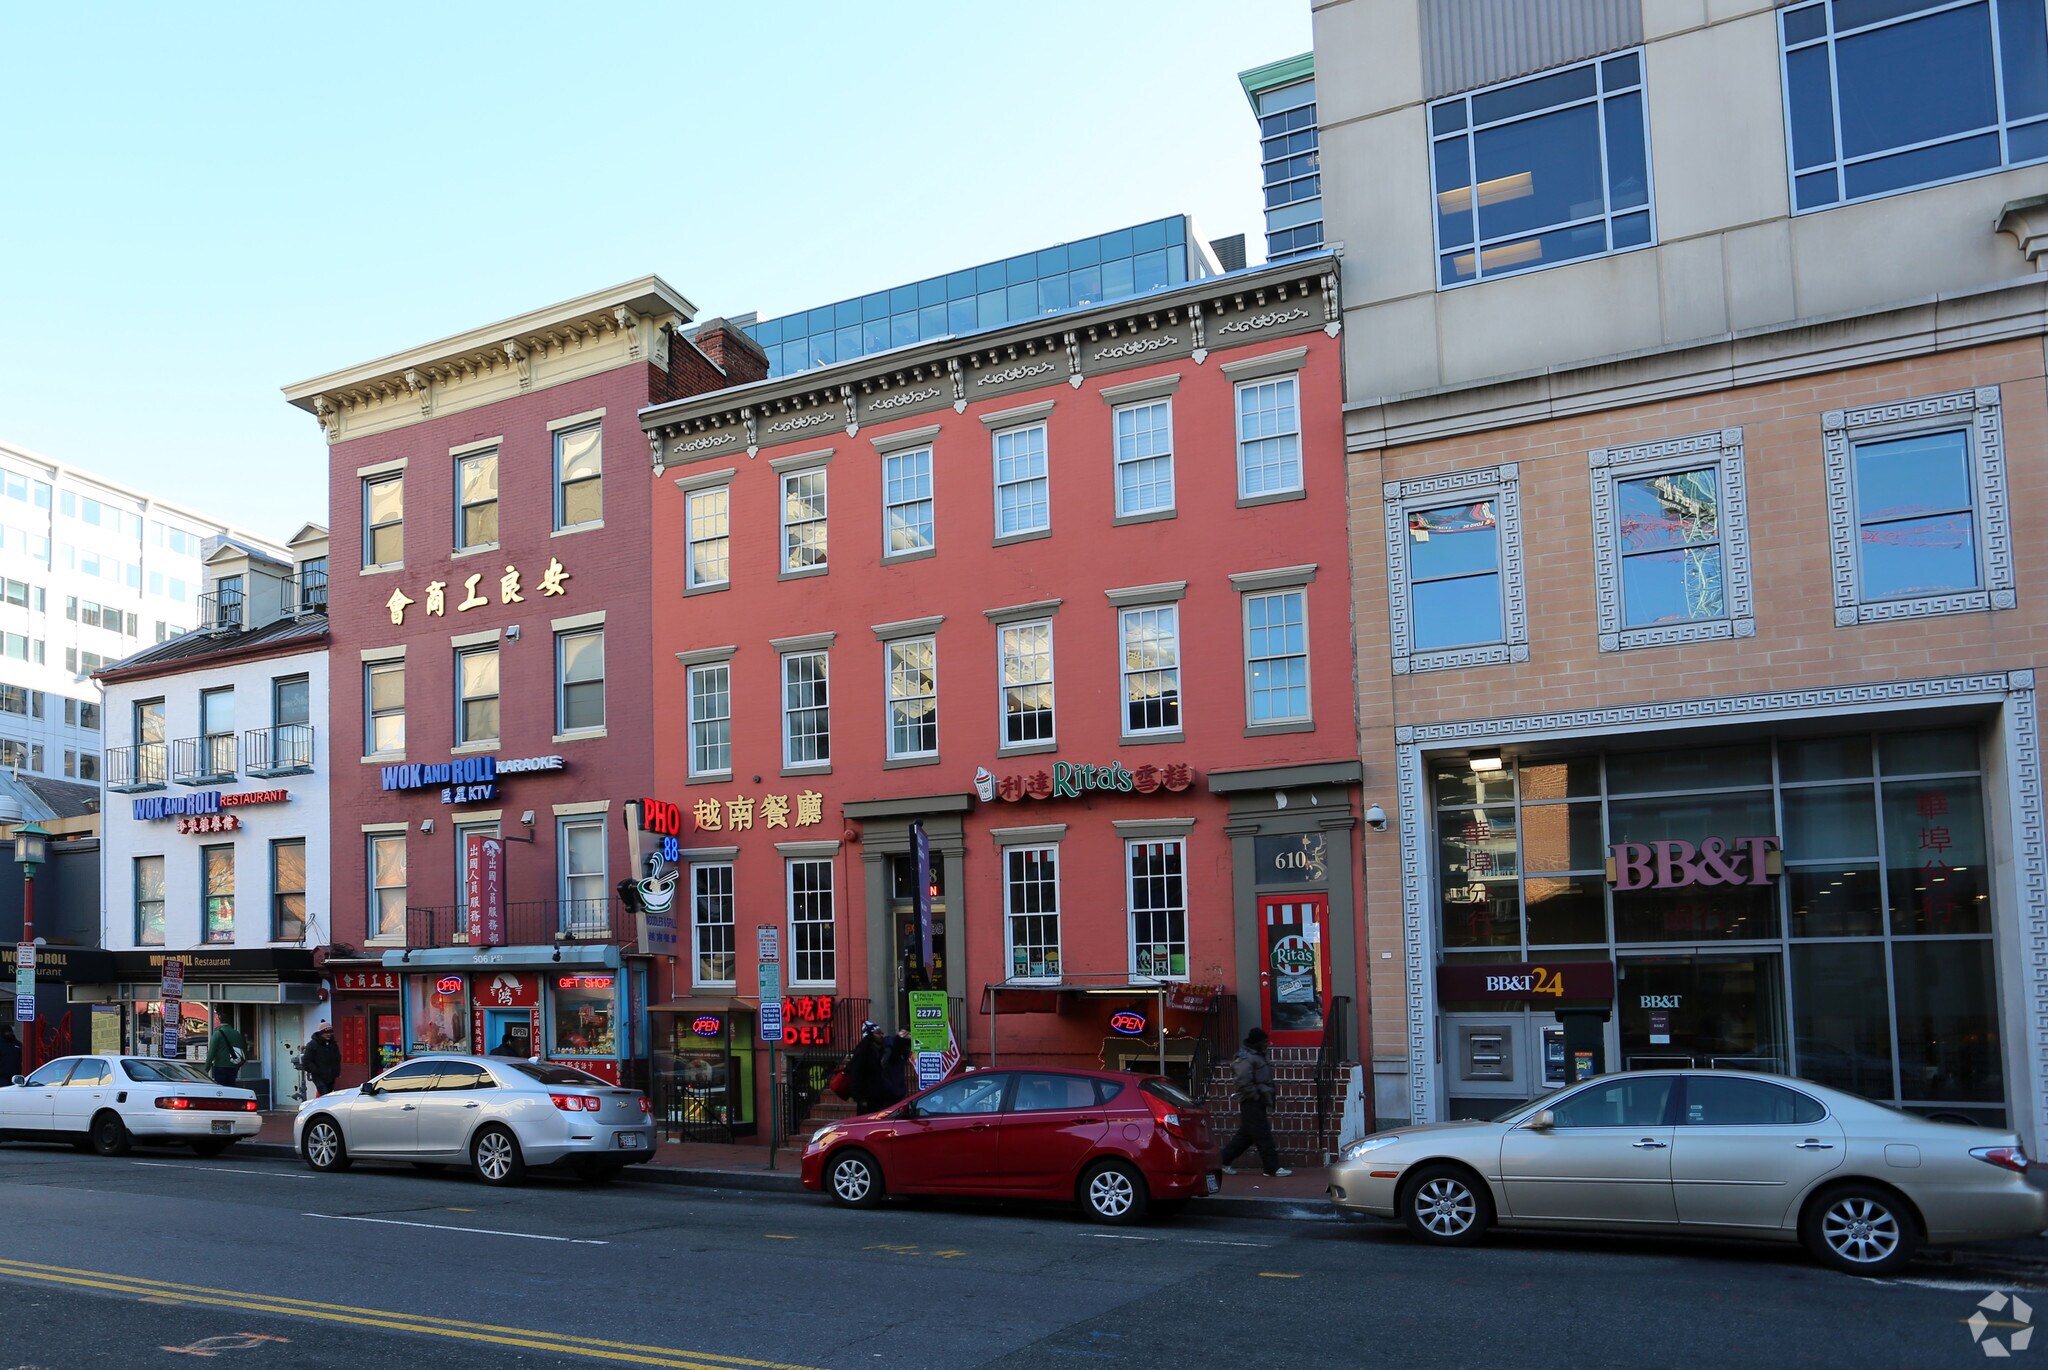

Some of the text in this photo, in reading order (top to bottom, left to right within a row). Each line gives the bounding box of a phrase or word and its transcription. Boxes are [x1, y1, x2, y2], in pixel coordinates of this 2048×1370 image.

[381, 755, 564, 791] WOK AND ROLL KARAOKE
[1052, 760, 1134, 798] Rita's
[1134, 762, 1191, 792] 雪糕
[133, 789, 283, 820] WOK AND ROLL RESTAURANT
[692, 789, 824, 833] 越南餐廳
[643, 797, 681, 836] PHO
[663, 836, 679, 862] 88
[1275, 850, 1306, 870] 610
[1917, 791, 1956, 924] 華埠分行
[1609, 836, 1781, 892] BB&T
[1462, 819, 1496, 937] 華埠分行
[469, 844, 480, 937] 出國人員服務部
[1, 951, 18, 963] WO
[44, 953, 68, 965] ROLL
[194, 957, 231, 966] Restaurant
[1277, 948, 1313, 963] Rita's
[437, 979, 462, 992] OPEN
[559, 977, 610, 989] GIFT SHOP
[782, 994, 833, 1023] 小吃店
[1640, 995, 1682, 1008] BB&T
[916, 1009, 942, 1018] 22773
[1110, 1015, 1146, 1031] OPEN
[513, 1028, 528, 1037] OPEN
[692, 1020, 720, 1032] OPEN
[783, 1026, 832, 1045] DELI
